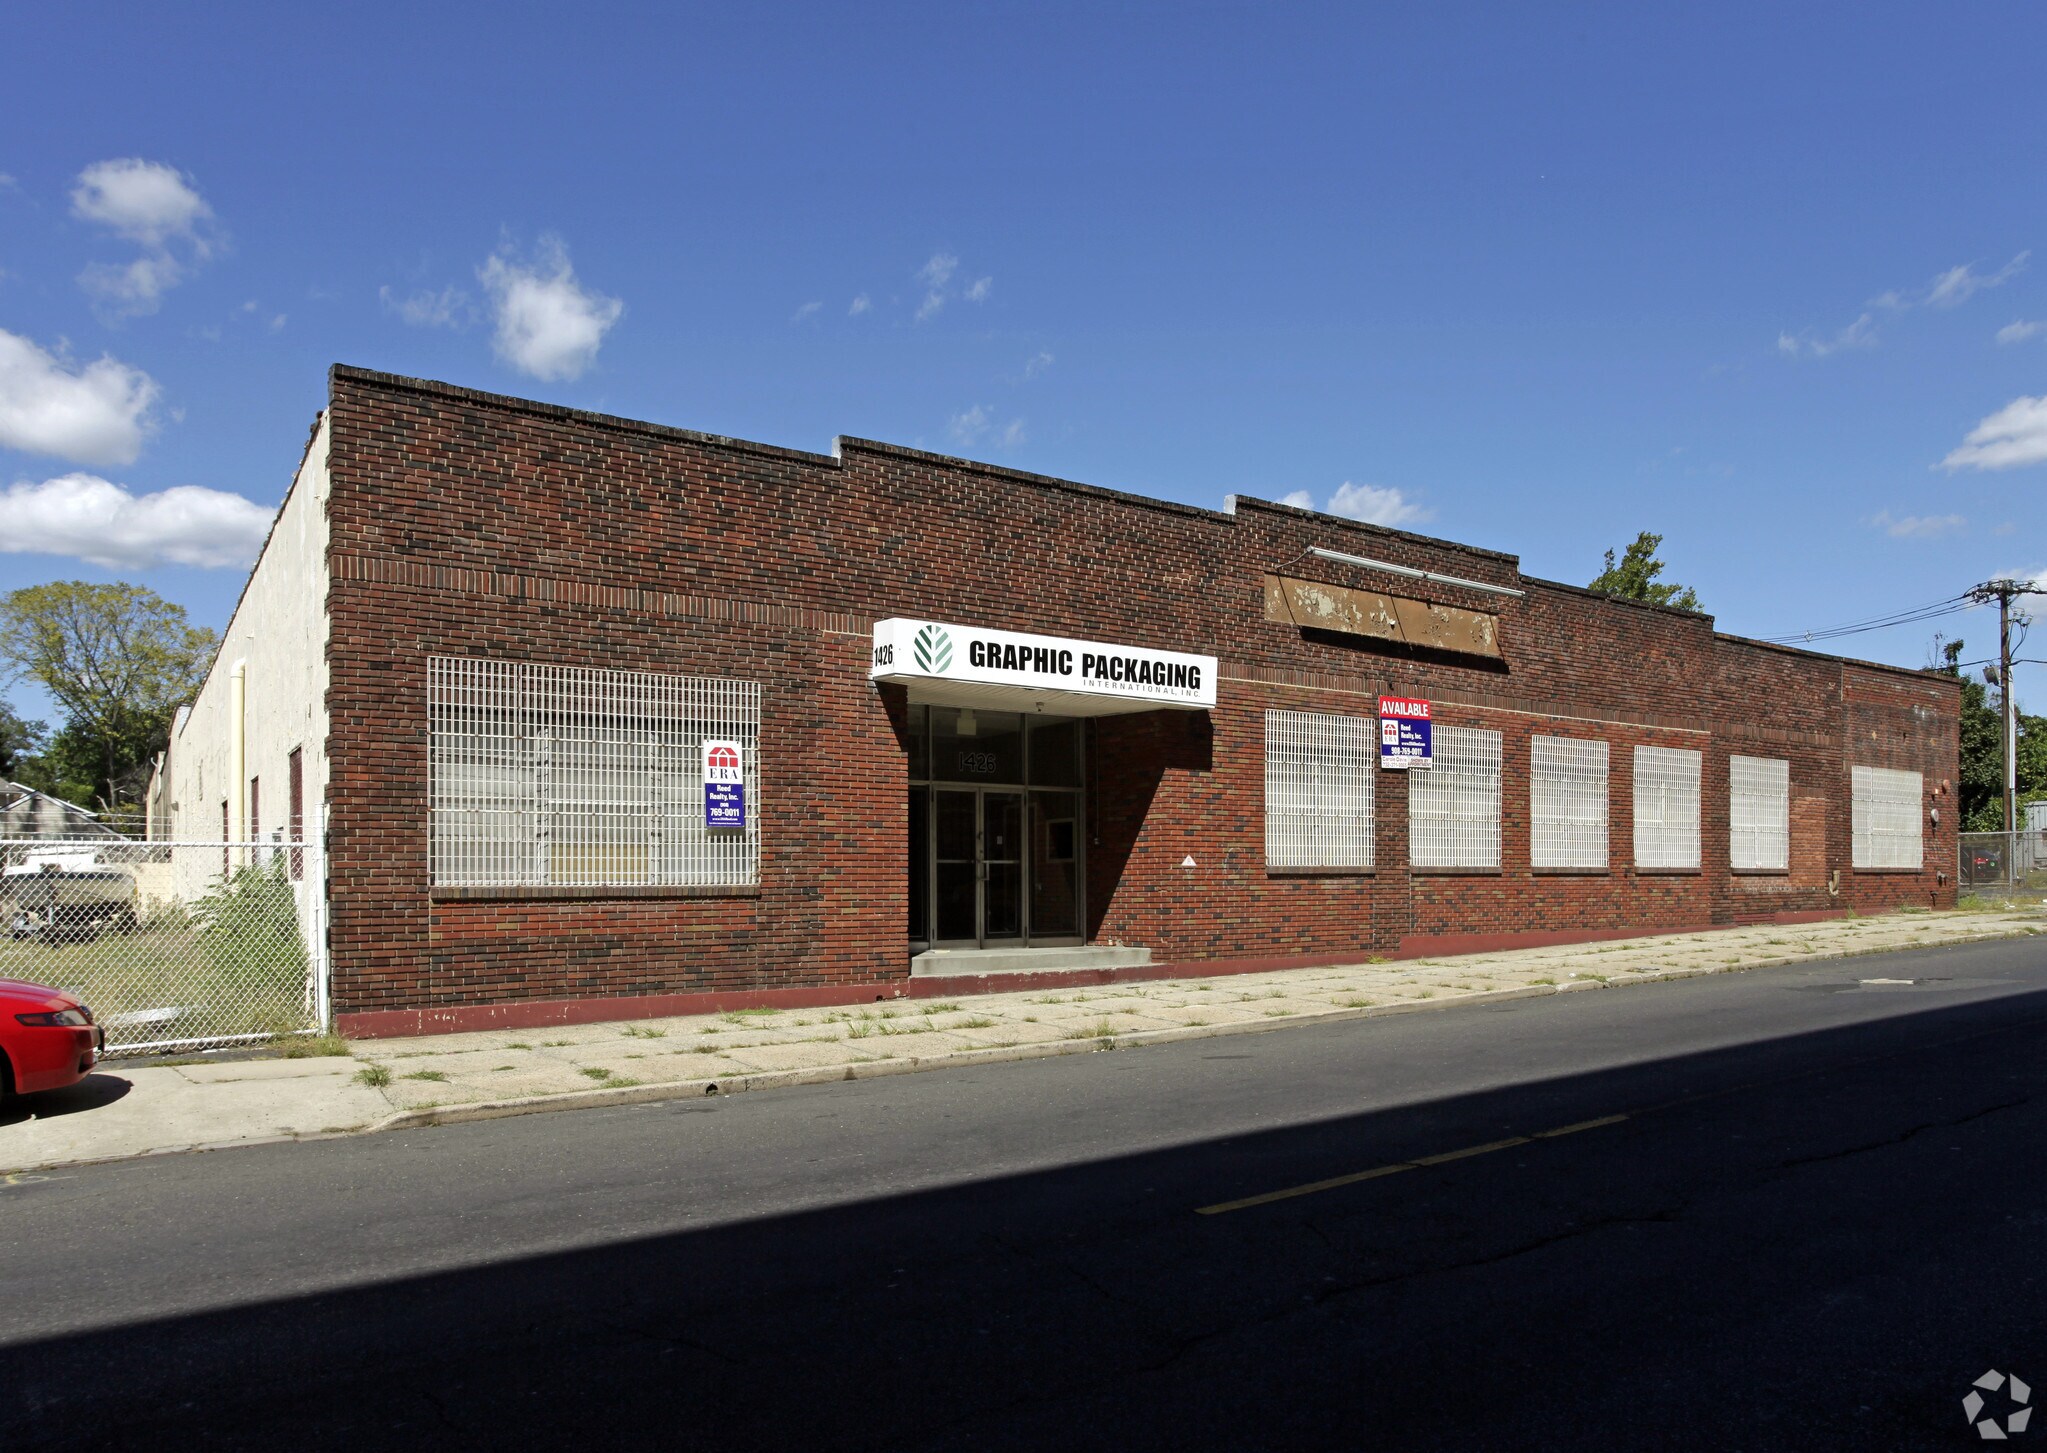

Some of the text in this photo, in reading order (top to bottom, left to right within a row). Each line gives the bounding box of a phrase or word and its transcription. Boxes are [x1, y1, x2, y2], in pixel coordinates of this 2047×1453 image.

[874, 643, 893, 667] 1426
[969, 640, 1201, 690] GRAPHIC PACKAGING
[1181, 689, 1201, 698] INC.
[1382, 700, 1428, 716] AVAILABLE
[959, 751, 997, 773] 1426
[709, 768, 738, 779] ERA
[710, 808, 739, 817] 769-0011
